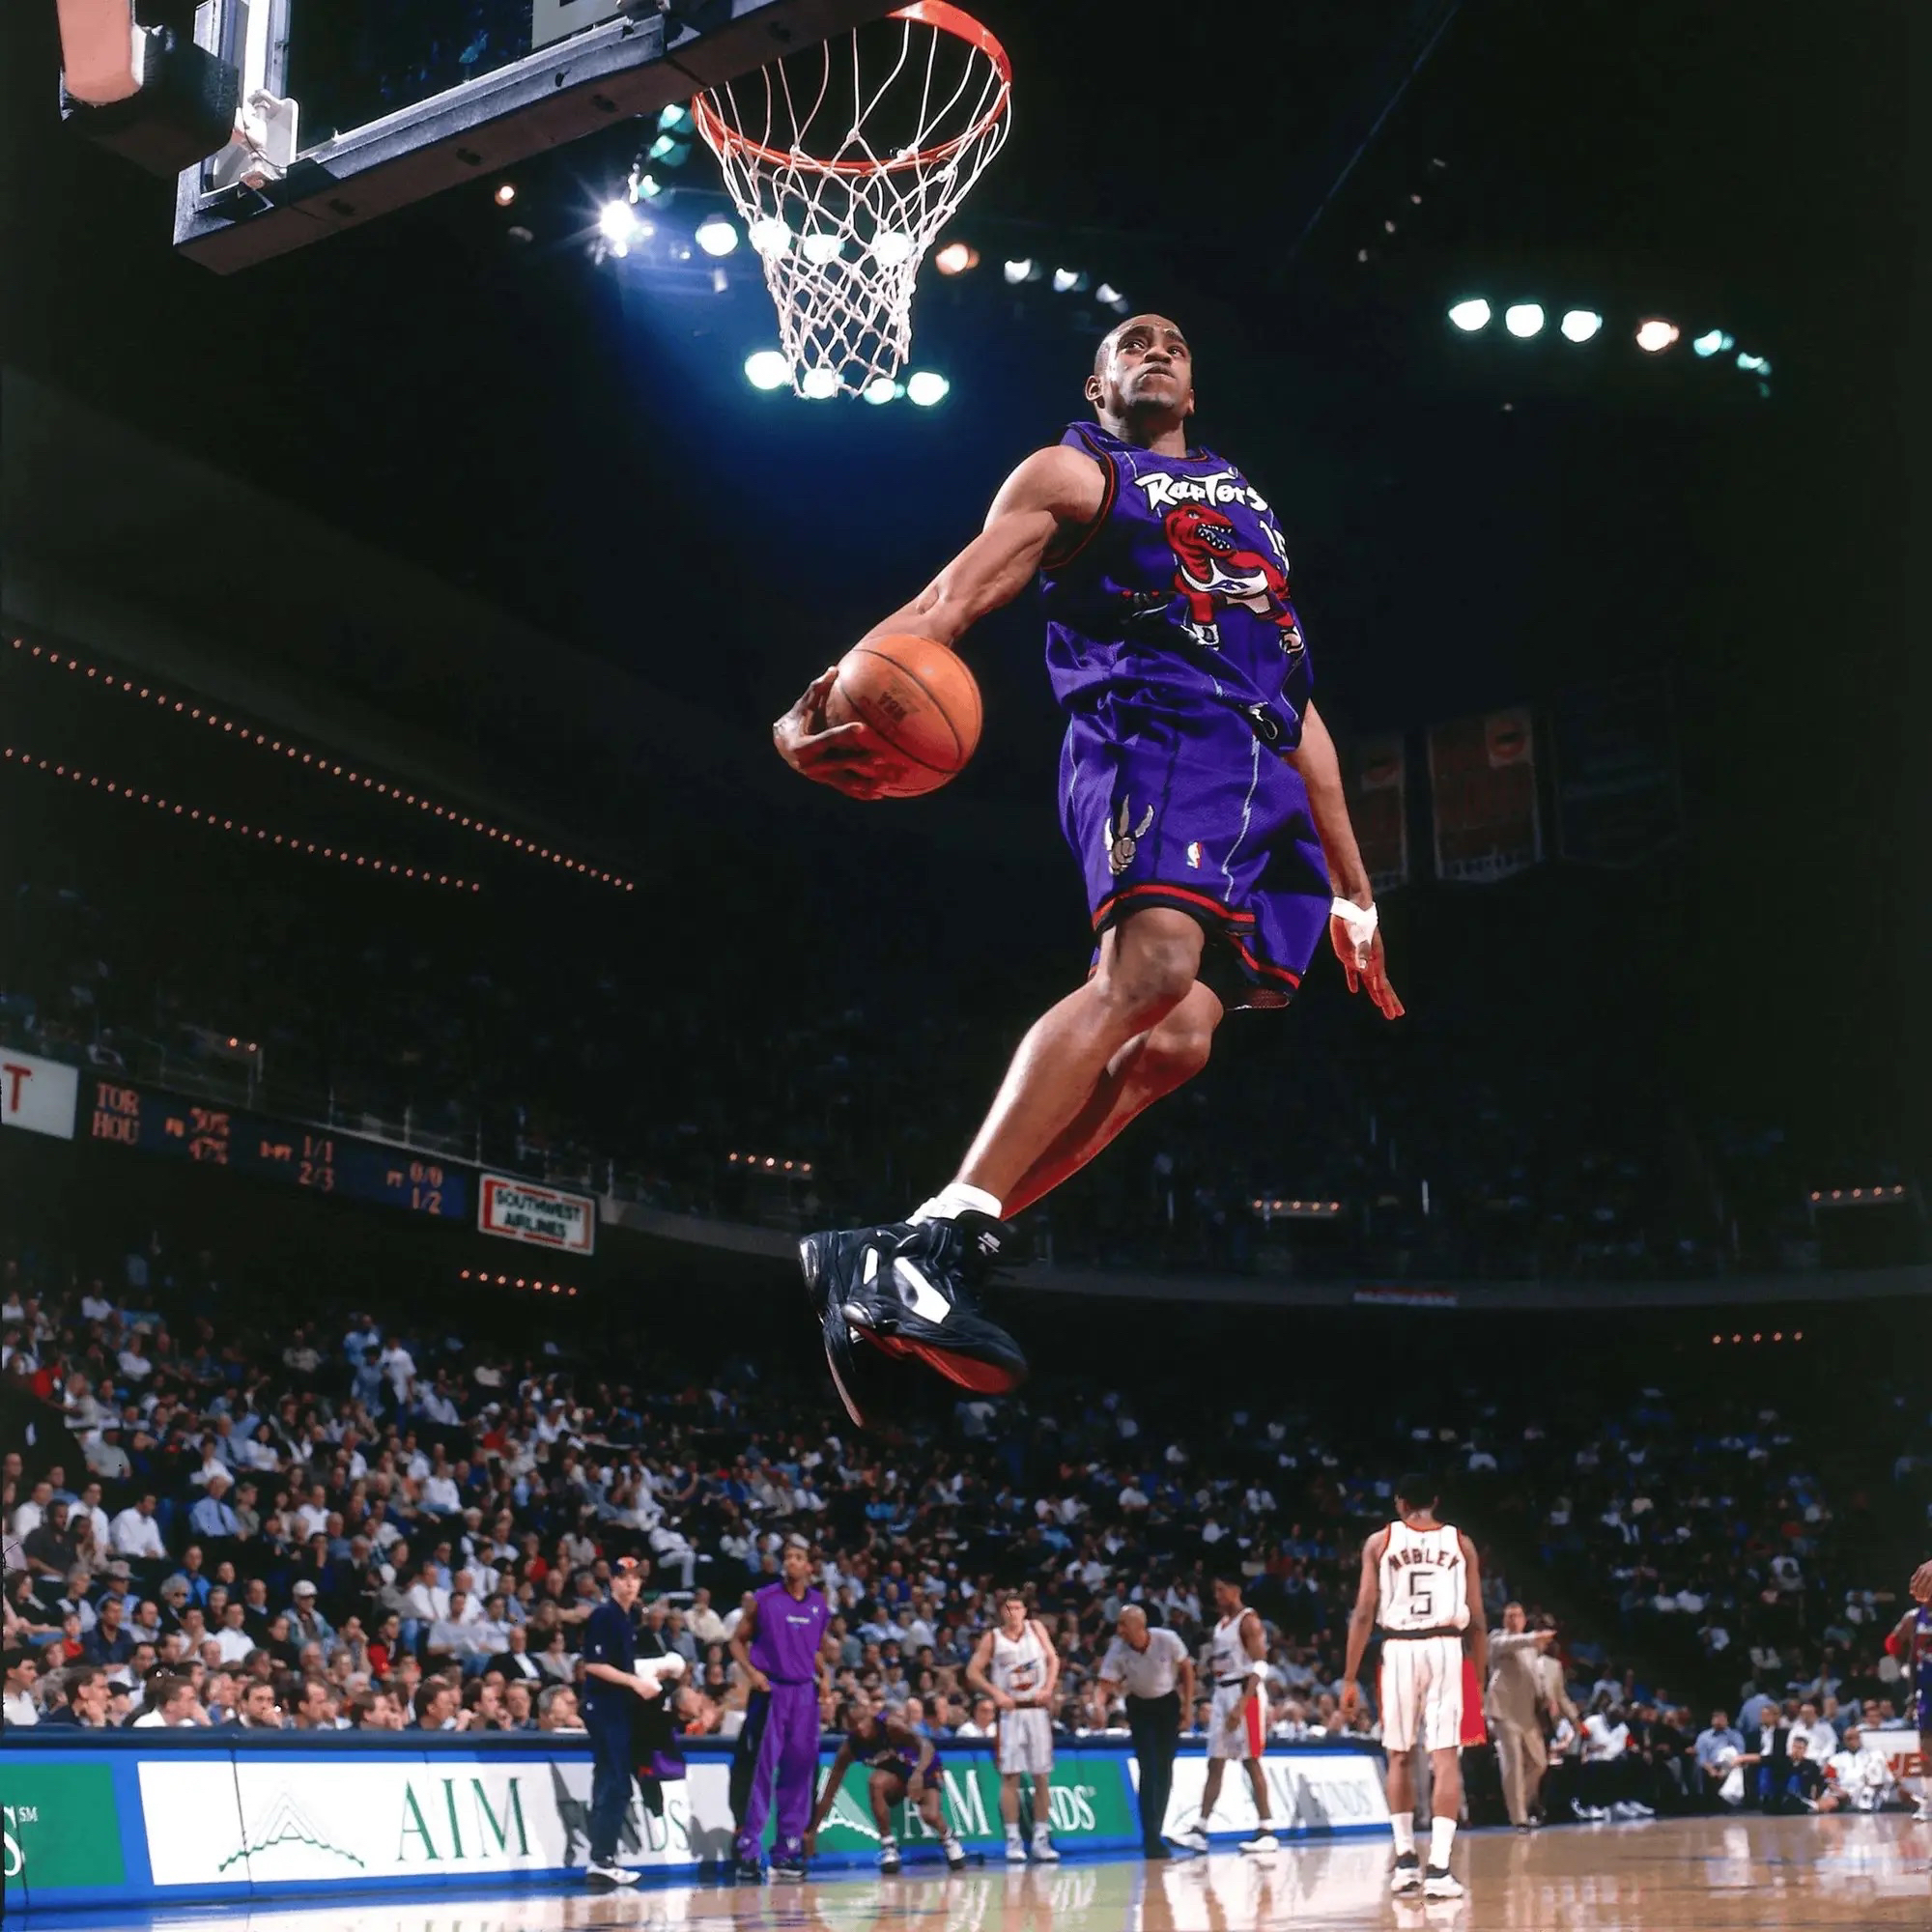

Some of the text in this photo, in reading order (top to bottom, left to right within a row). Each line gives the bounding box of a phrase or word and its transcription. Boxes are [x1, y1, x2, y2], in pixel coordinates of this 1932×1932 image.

[3, 1063, 32, 1113] T
[98, 1082, 139, 1117] TOR
[303, 1135, 334, 1163] 1/1
[92, 1111, 140, 1146] HOU
[412, 1186, 442, 1215] 1/2
[495, 1187, 581, 1222] SOUTHWEST
[504, 1212, 567, 1238] AIRLINES
[1388, 1548, 1460, 1571] MOBLEY
[1409, 1571, 1435, 1615] 5
[395, 1777, 531, 1862] AIM
